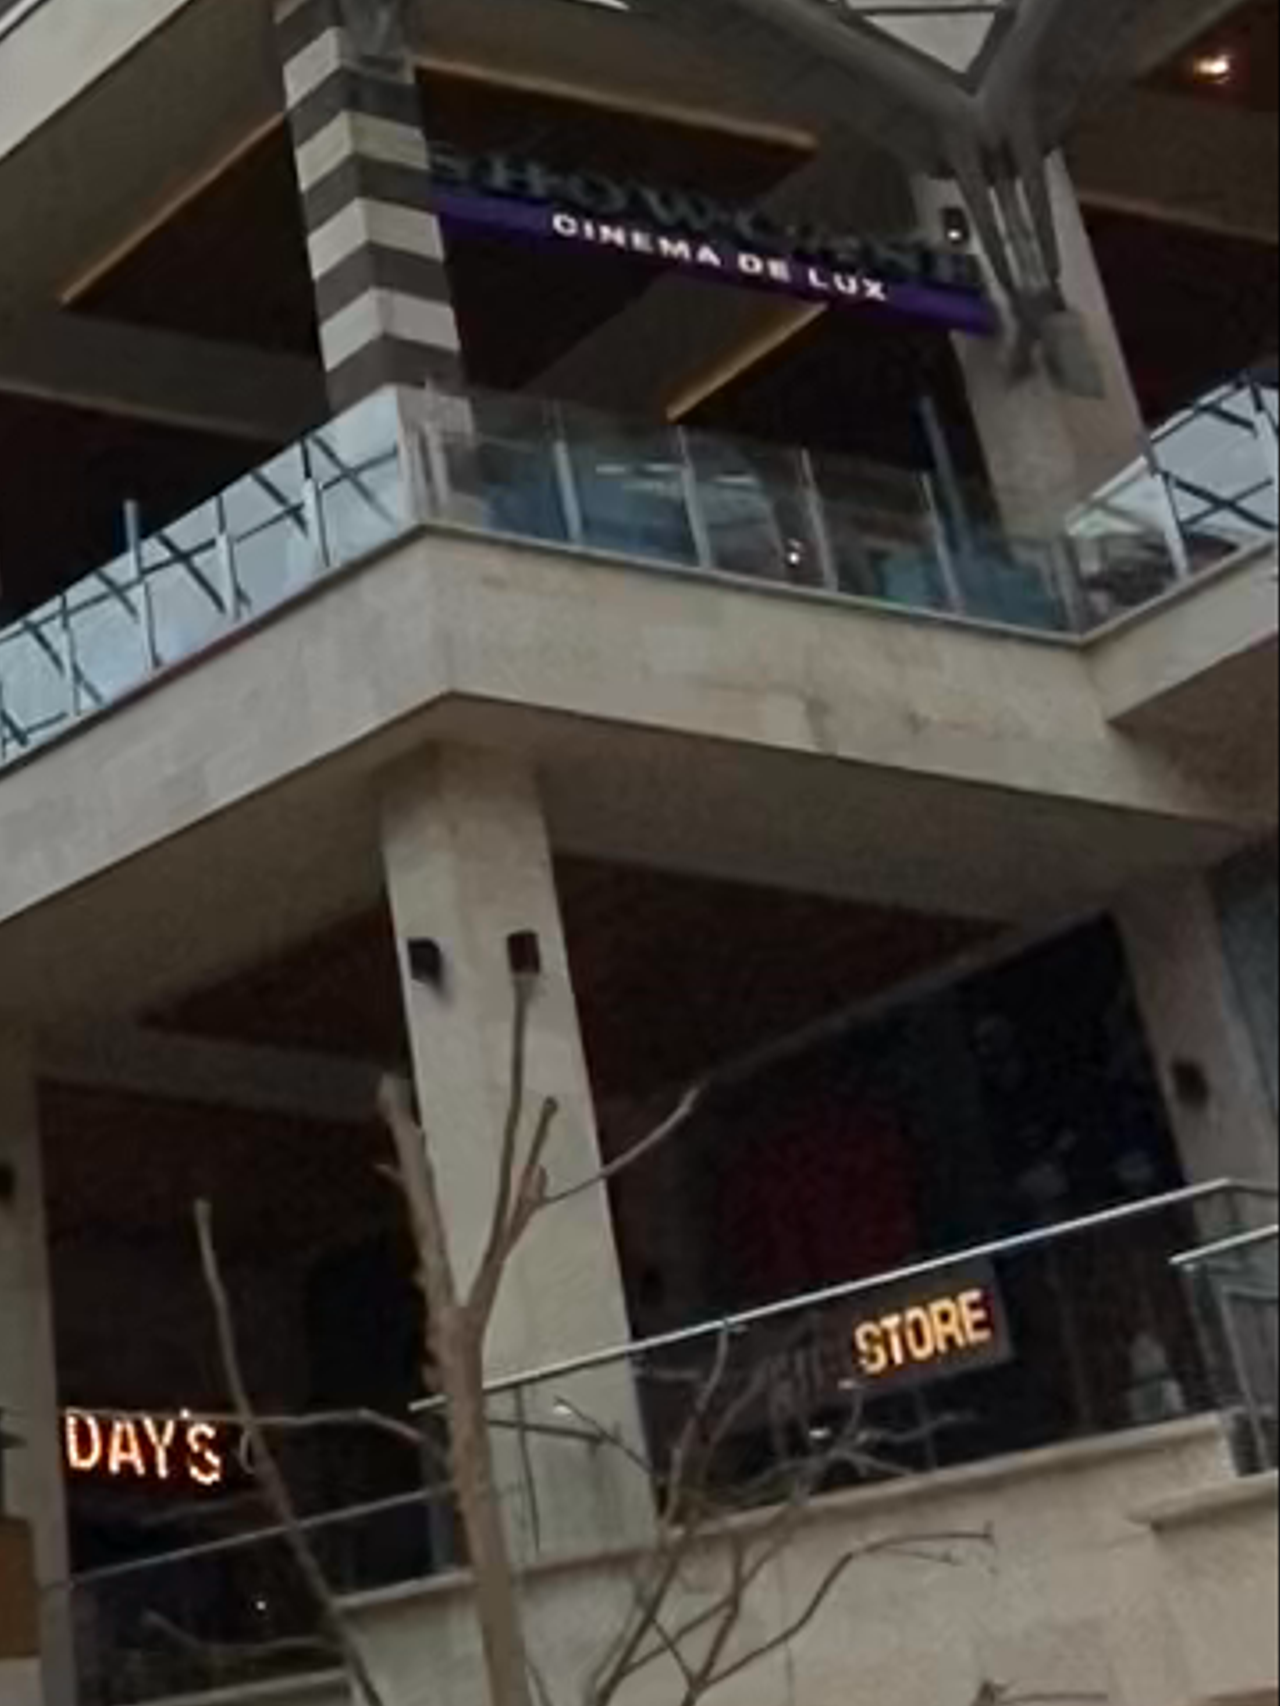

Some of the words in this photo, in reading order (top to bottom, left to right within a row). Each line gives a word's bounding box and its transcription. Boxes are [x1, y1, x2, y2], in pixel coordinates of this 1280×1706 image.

[552, 213, 721, 268] CINEMA
[737, 252, 790, 283] DE
[807, 267, 887, 302] LUX
[853, 1287, 993, 1376] STORE
